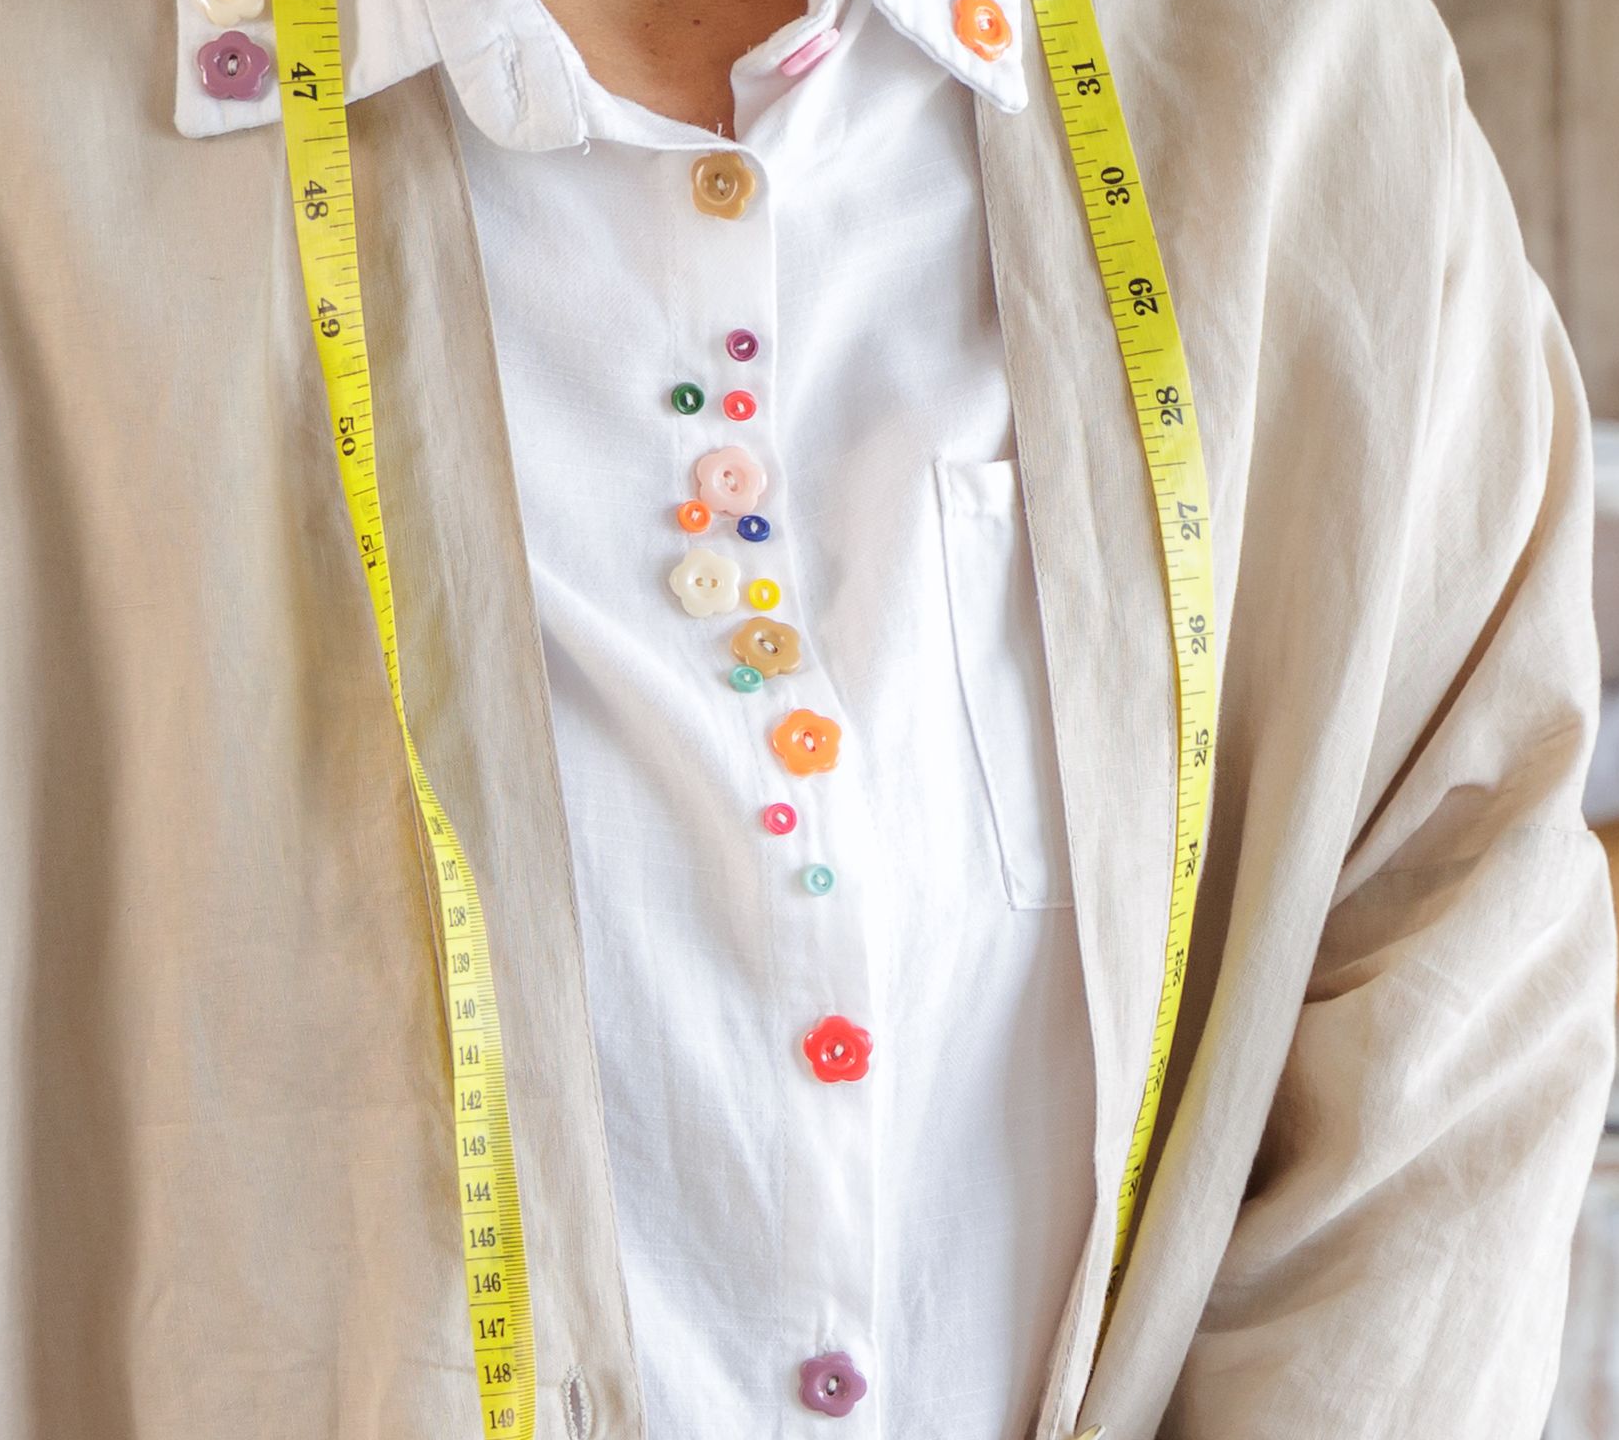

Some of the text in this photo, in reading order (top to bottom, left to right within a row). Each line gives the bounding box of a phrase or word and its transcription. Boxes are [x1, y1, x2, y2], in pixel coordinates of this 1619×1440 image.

[291, 62, 318, 101] 47
[1072, 58, 1101, 96] 31
[1101, 166, 1130, 205] 30
[304, 180, 329, 220] 48
[1128, 277, 1158, 315] 29
[317, 297, 341, 338] 49
[1156, 386, 1183, 425] 28
[339, 416, 356, 456] 50
[1177, 501, 1200, 540] 27
[1189, 614, 1206, 654] 26
[1194, 728, 1209, 767] 25
[441, 860, 459, 881] 137
[447, 906, 467, 927] 138
[451, 955, 470, 974] 139
[455, 999, 476, 1020] 140
[459, 1045, 480, 1066] 141
[460, 1090, 481, 1111] 142
[462, 1136, 486, 1157] 143
[465, 1182, 491, 1202] 144
[469, 1227, 496, 1248] 145
[473, 1273, 501, 1294] 146
[478, 1317, 506, 1339] 147
[484, 1362, 512, 1384] 148
[489, 1407, 515, 1430] 149
